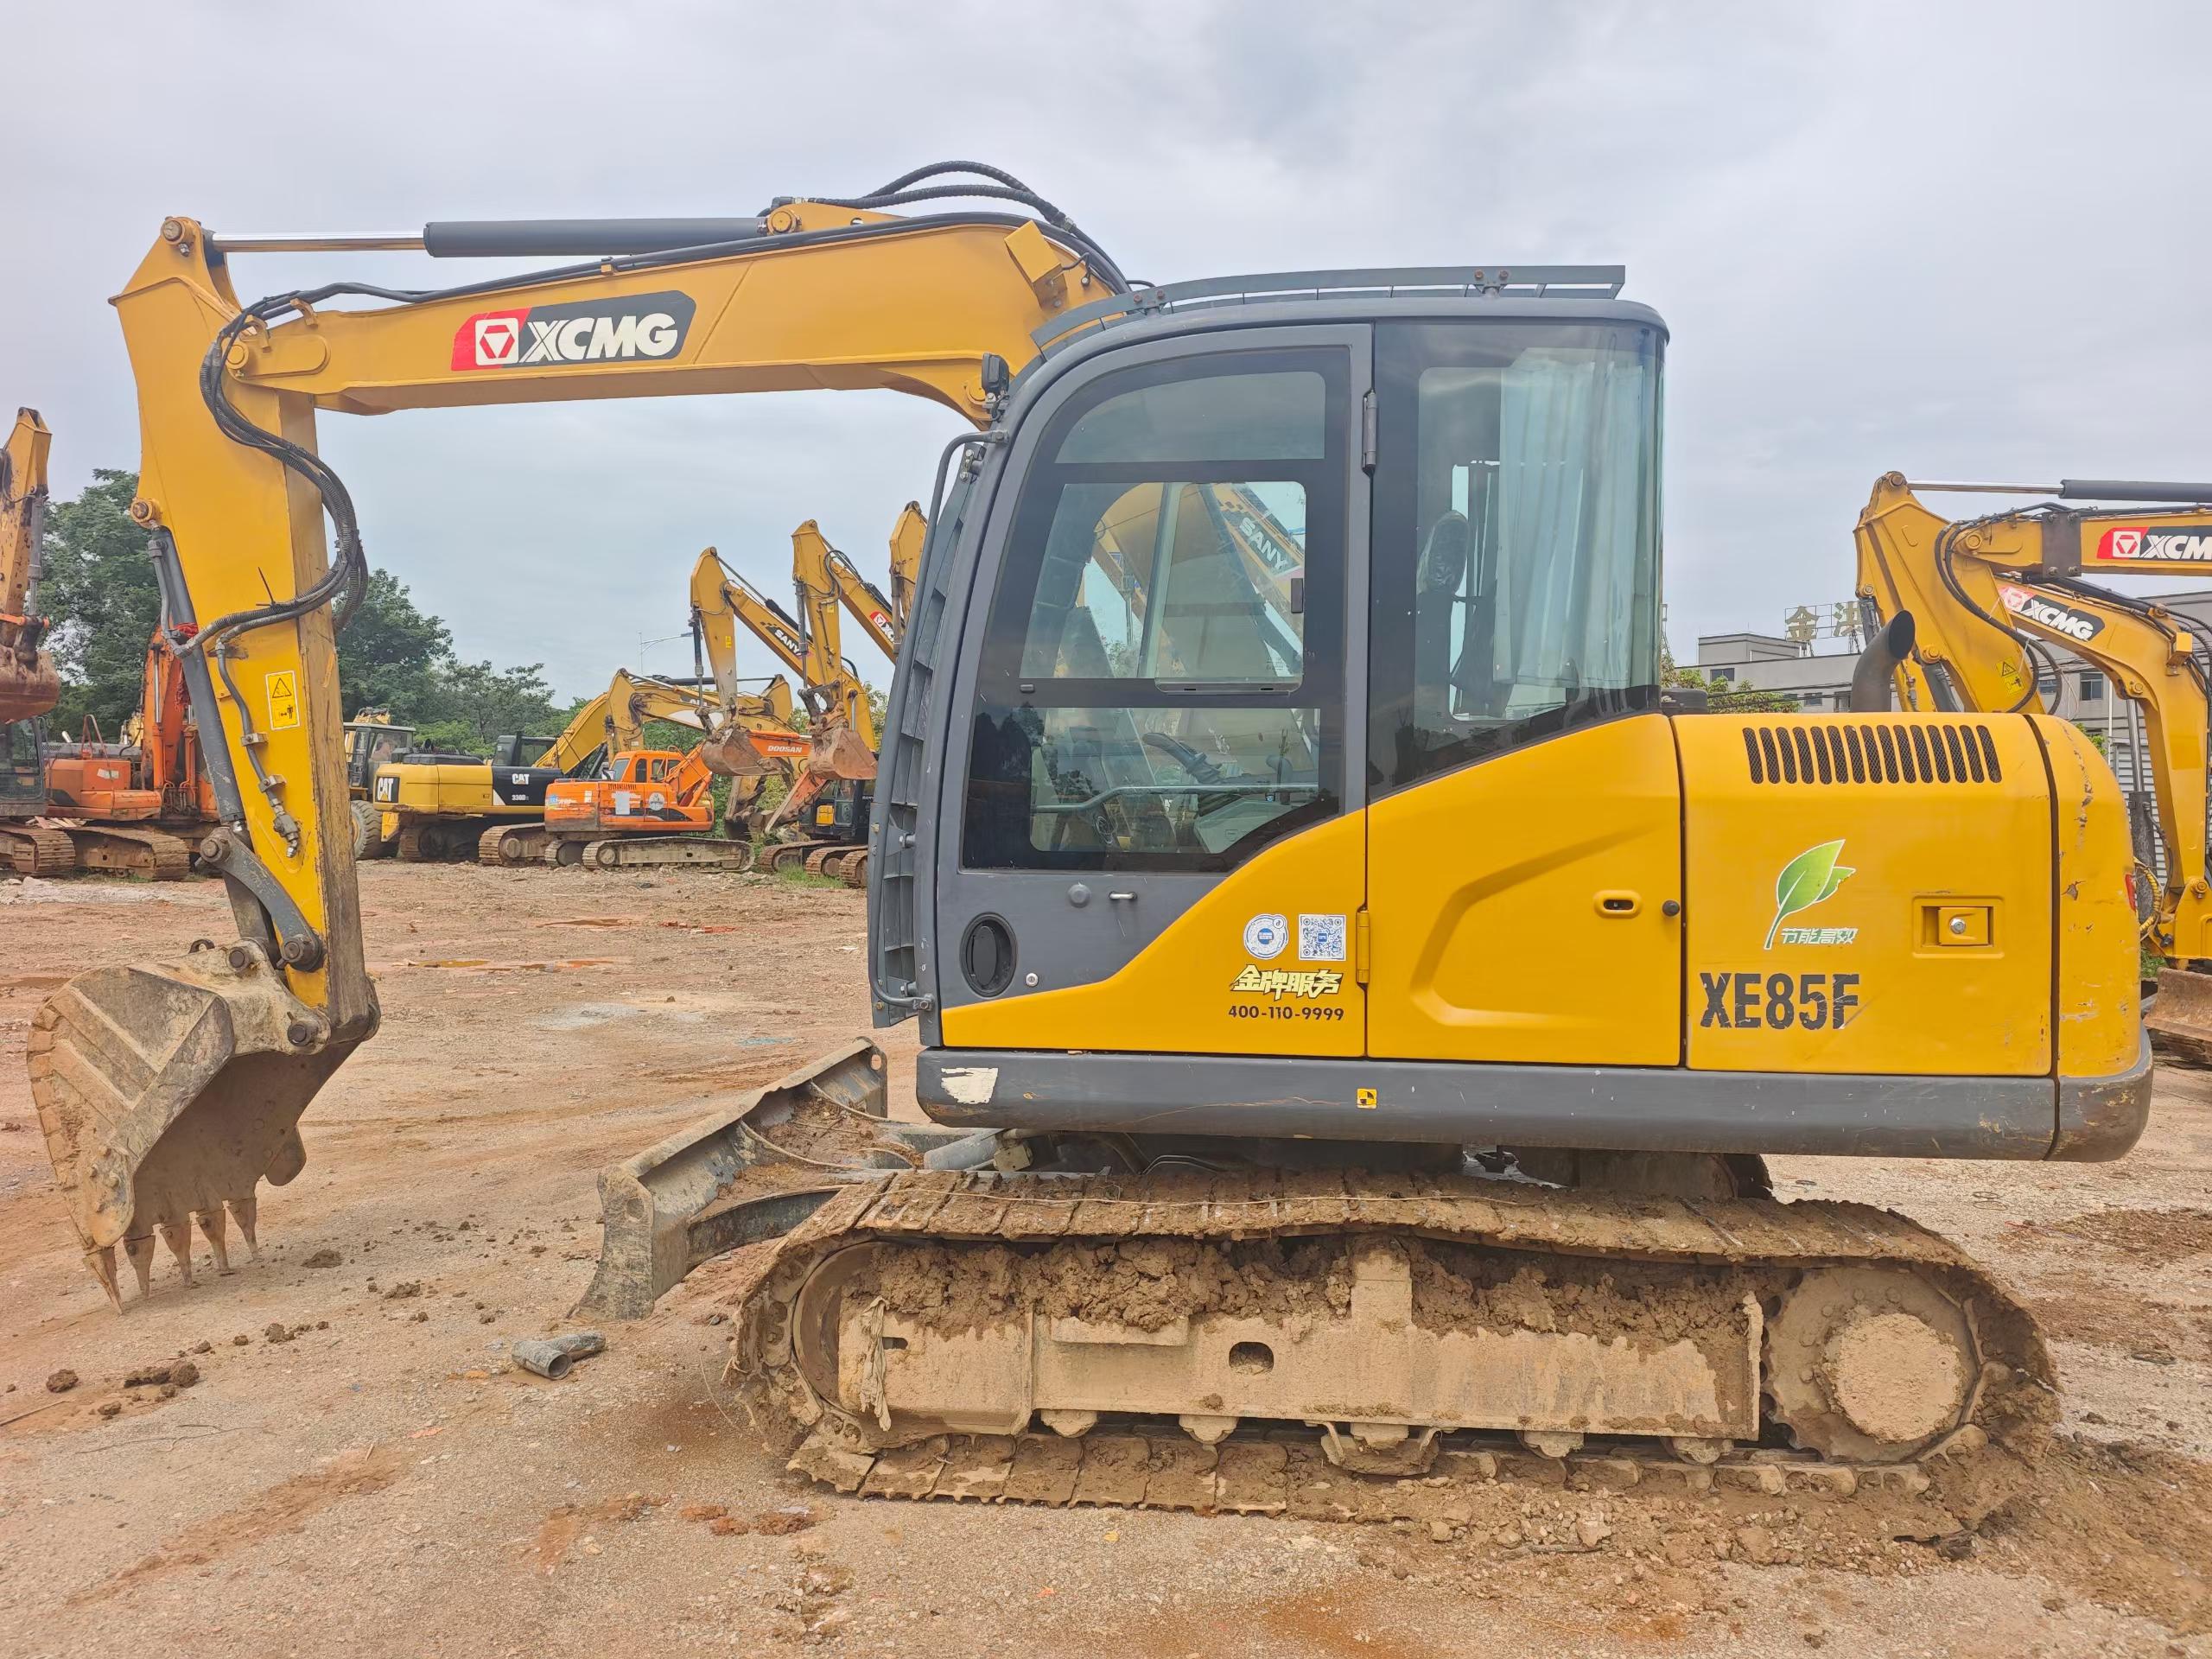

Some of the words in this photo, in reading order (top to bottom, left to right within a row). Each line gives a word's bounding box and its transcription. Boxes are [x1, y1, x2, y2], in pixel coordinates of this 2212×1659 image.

[519, 313, 678, 363] XCMG
[1239, 517, 1288, 570] SANY
[881, 622, 895, 643] XC
[2020, 599, 2094, 642] XCMG
[774, 629, 801, 654] SANY
[767, 745, 803, 753] DOOSAN
[378, 778, 393, 802] CAT
[512, 773, 530, 785] CAT
[1782, 928, 1859, 945] 节能高效
[1230, 964, 1344, 1001] 金牌服务
[1228, 1005, 1344, 1020] 400-110-9999
[1700, 972, 1859, 1030] XE85F
